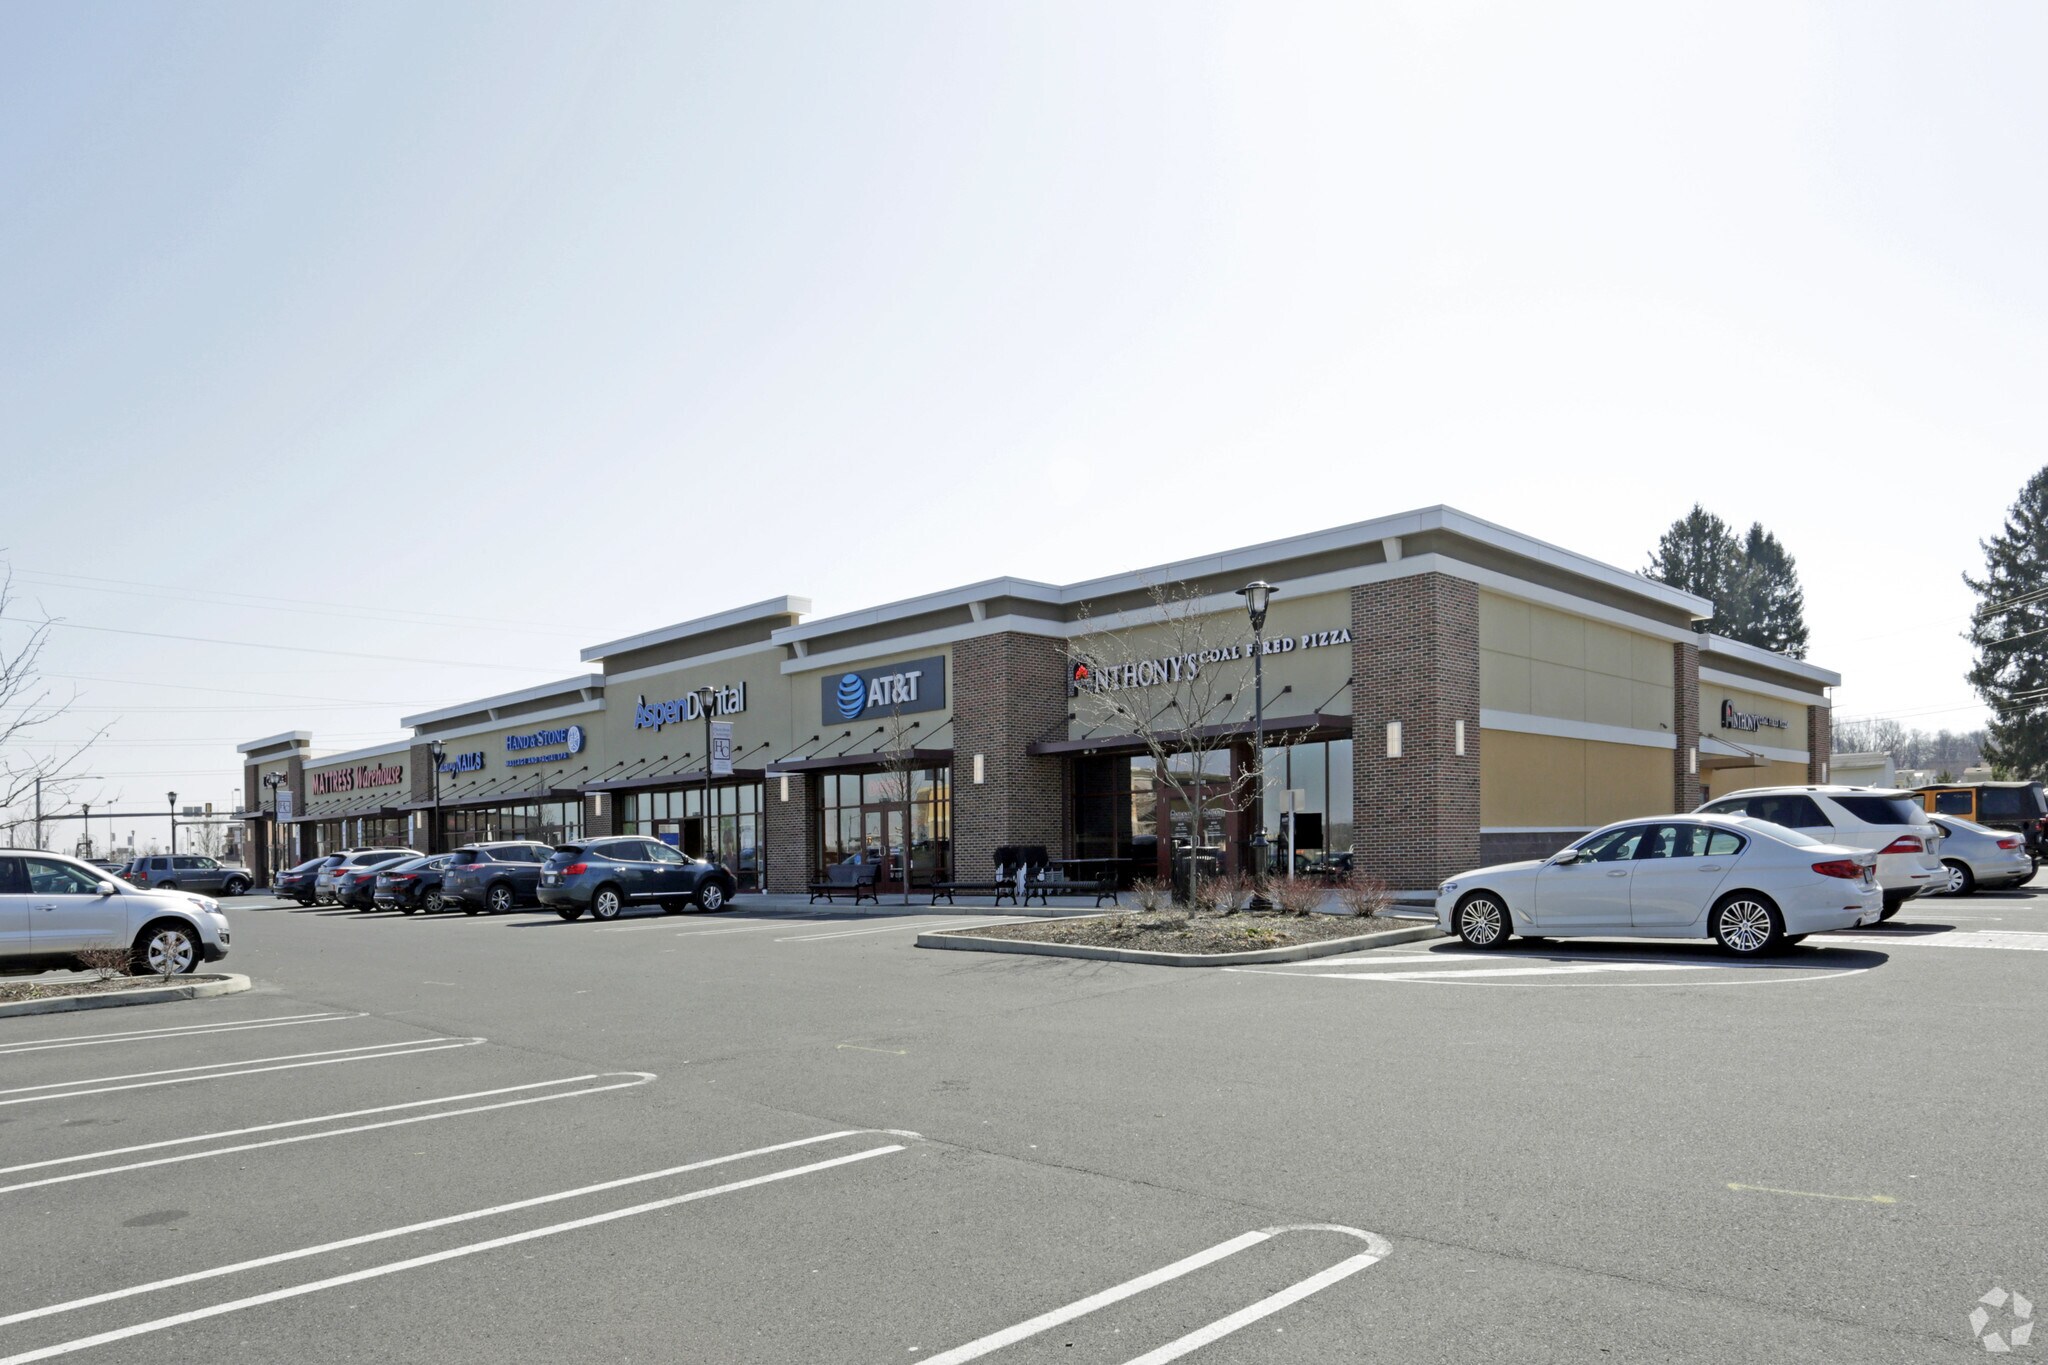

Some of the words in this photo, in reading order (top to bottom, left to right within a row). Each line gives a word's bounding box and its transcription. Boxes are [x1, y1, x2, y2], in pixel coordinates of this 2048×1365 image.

[1199, 646, 1240, 663] COAL
[1243, 637, 1291, 658] FRED
[1301, 628, 1350, 649] PIZZA
[867, 671, 922, 708] AT&T
[456, 751, 483, 773] NAILS
[312, 768, 354, 796] MATTRESS
[355, 763, 402, 790] Warehouse
